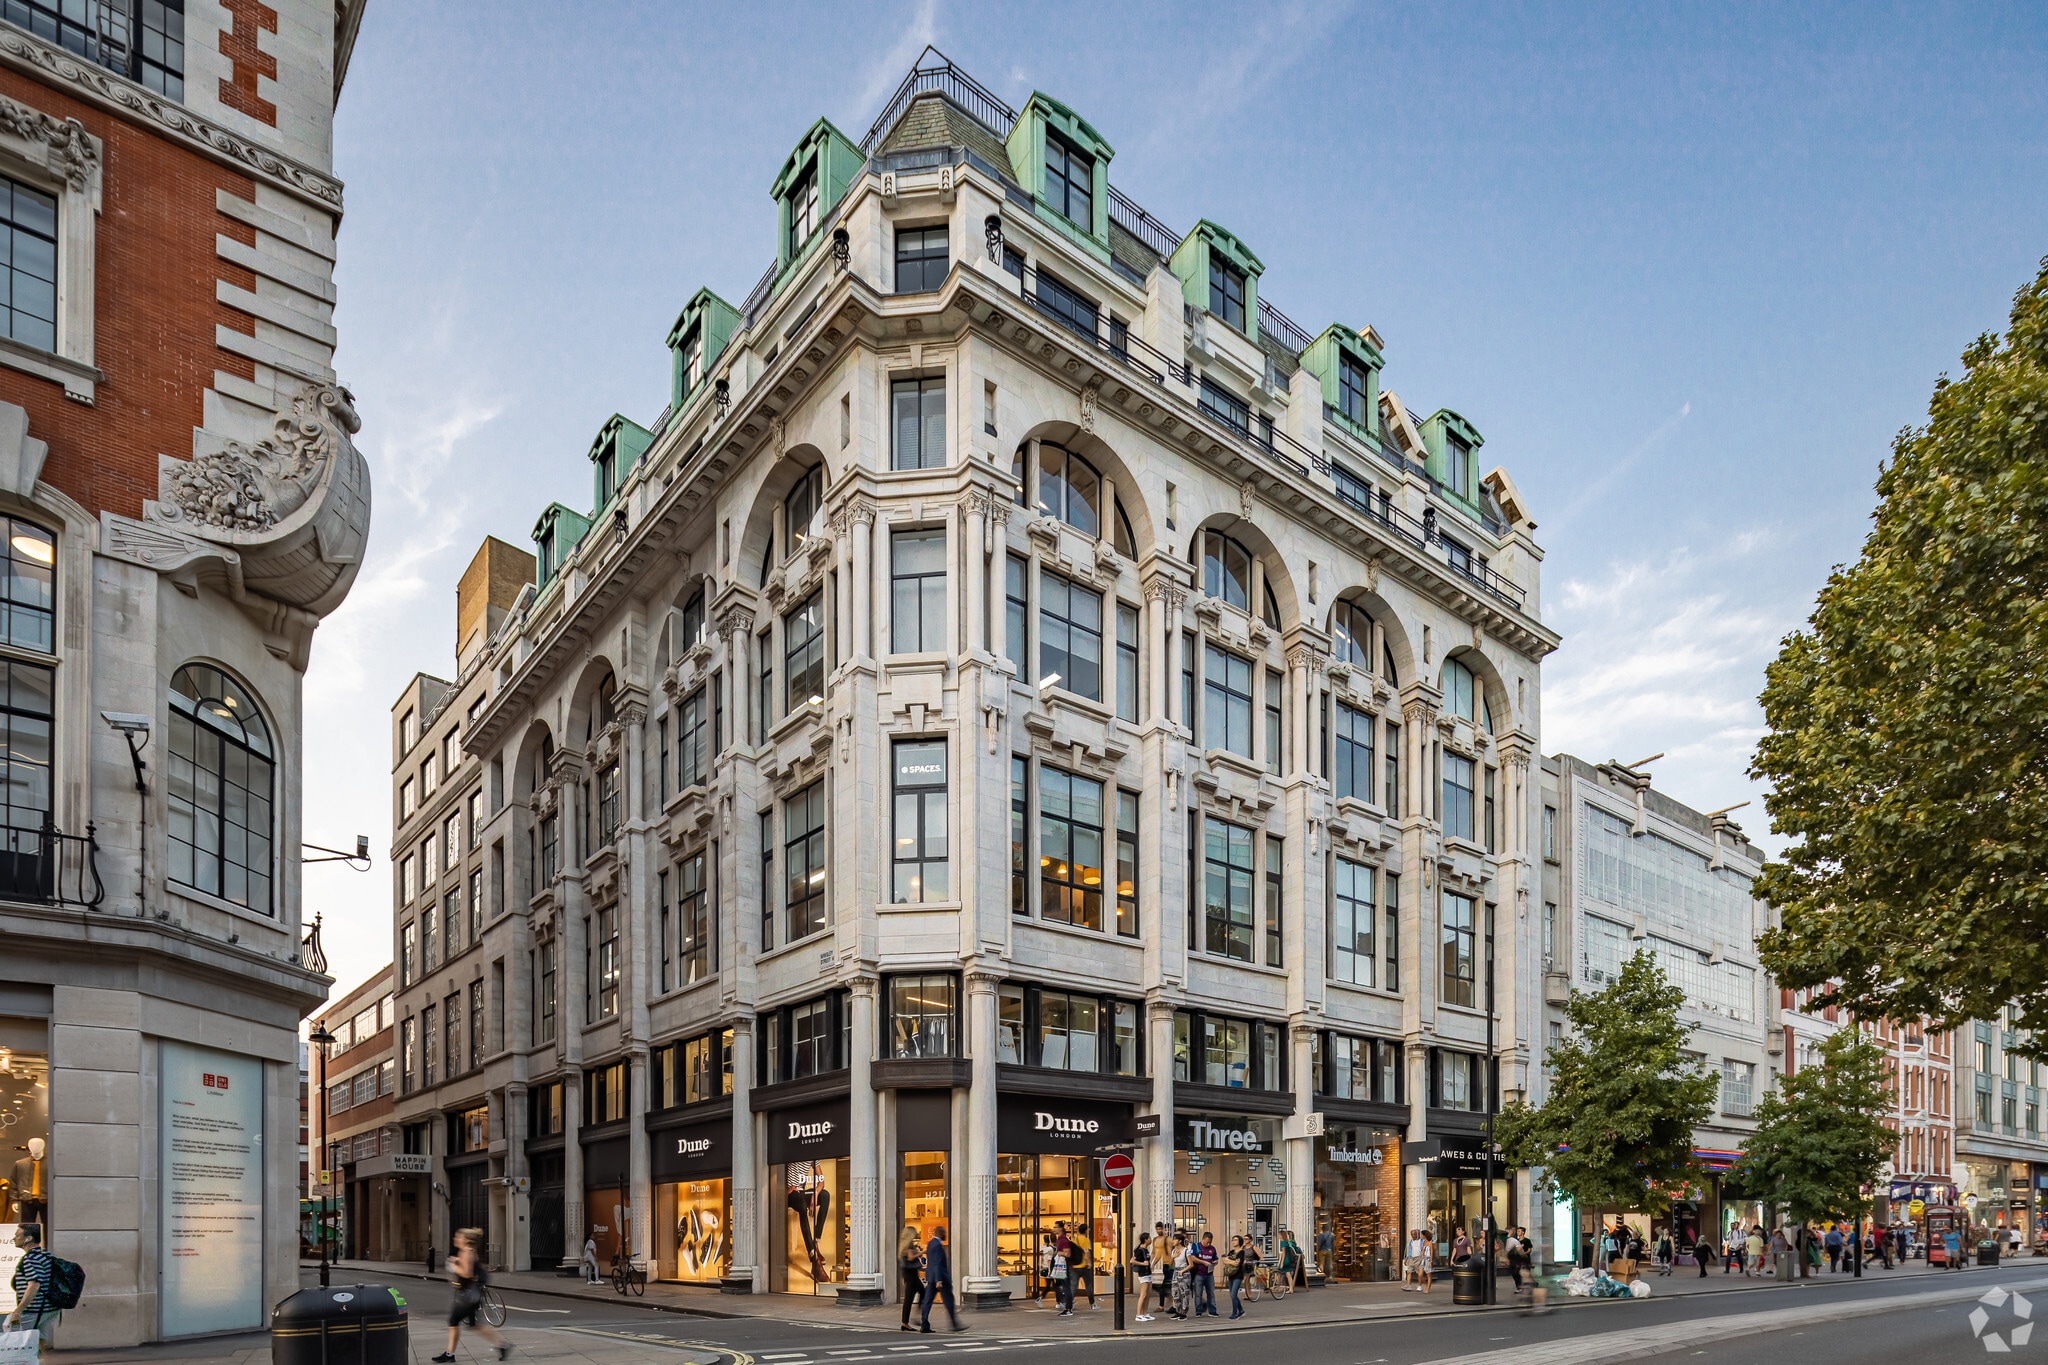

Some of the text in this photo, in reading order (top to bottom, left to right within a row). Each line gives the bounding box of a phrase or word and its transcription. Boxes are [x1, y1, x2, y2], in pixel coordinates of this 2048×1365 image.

[909, 764, 942, 773] SPACES.
[1035, 1112, 1099, 1133] Dune
[1137, 1122, 1156, 1130] Dune
[788, 1121, 831, 1139] Dune
[1188, 1120, 1262, 1151] Three.
[801, 1137, 823, 1145] LONDON
[678, 1139, 710, 1154] Dune
[1328, 1145, 1371, 1163] Timberland
[1440, 1150, 1506, 1162] AWES & CUTIS
[394, 1156, 426, 1164] MAPPIN
[799, 1174, 824, 1184] Dune
[690, 1184, 710, 1193] Dune
[593, 1224, 608, 1232] Dune
